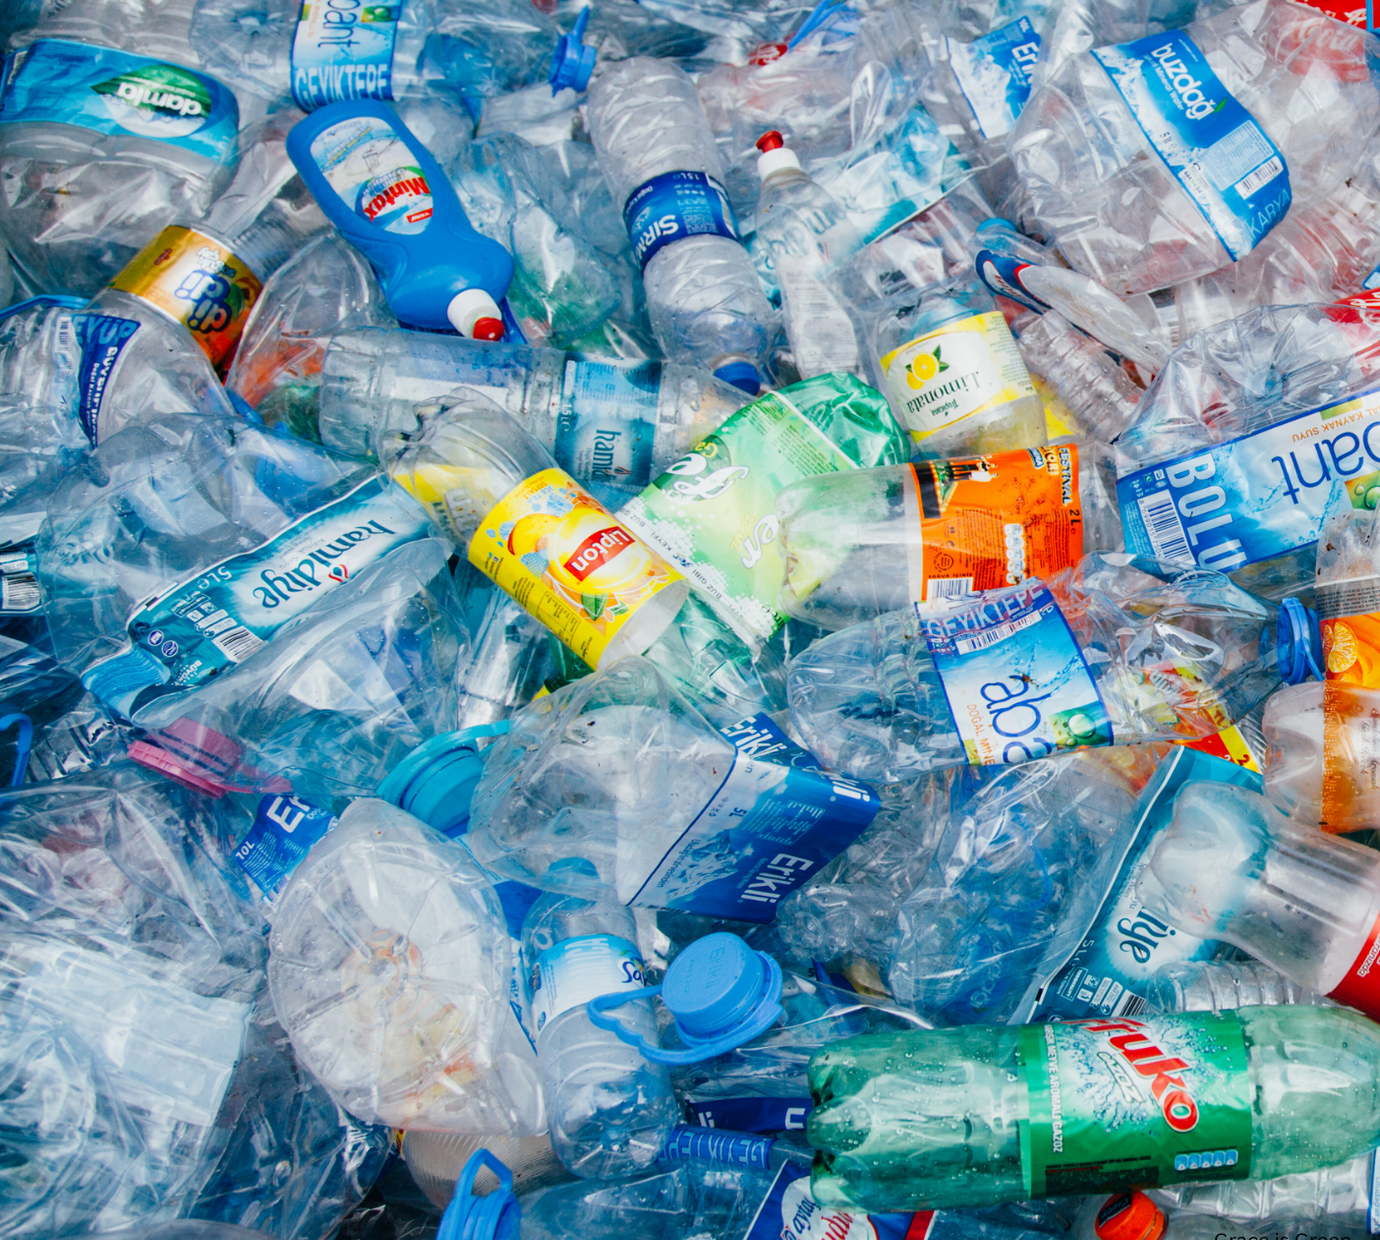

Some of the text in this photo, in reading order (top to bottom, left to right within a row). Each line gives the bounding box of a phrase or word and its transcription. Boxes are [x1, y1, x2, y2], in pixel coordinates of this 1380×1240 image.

[117, 81, 203, 119] damla
[1150, 42, 1217, 120] buzdağı
[1153, 66, 1173, 91] Mineral
[1169, 90, 1184, 111] Water
[363, 176, 432, 222] Mintax
[636, 213, 680, 266] SIRM
[173, 270, 233, 336] didi
[72, 314, 142, 347] EYÜP
[907, 359, 981, 414] Limonata
[929, 397, 960, 417] Tropicana
[1291, 426, 1320, 443] SUYU
[1320, 411, 1363, 433] KAYNAK
[1168, 458, 1248, 572] BOLU
[251, 518, 398, 612] hamidiye
[569, 526, 632, 576] Lipton
[690, 568, 708, 585] GİBİ
[705, 583, 722, 599] BUZ
[922, 581, 1045, 641] GEYİKTEPE
[718, 715, 787, 762] Erikli
[966, 704, 982, 742] DOĞAL
[979, 676, 1054, 766] aba
[235, 841, 256, 861] 10L
[740, 851, 815, 905] Erikli
[1047, 1045, 1062, 1153] MEYVE AROMALI GAZOZ
[1096, 1050, 1145, 1104] GAZOZ
